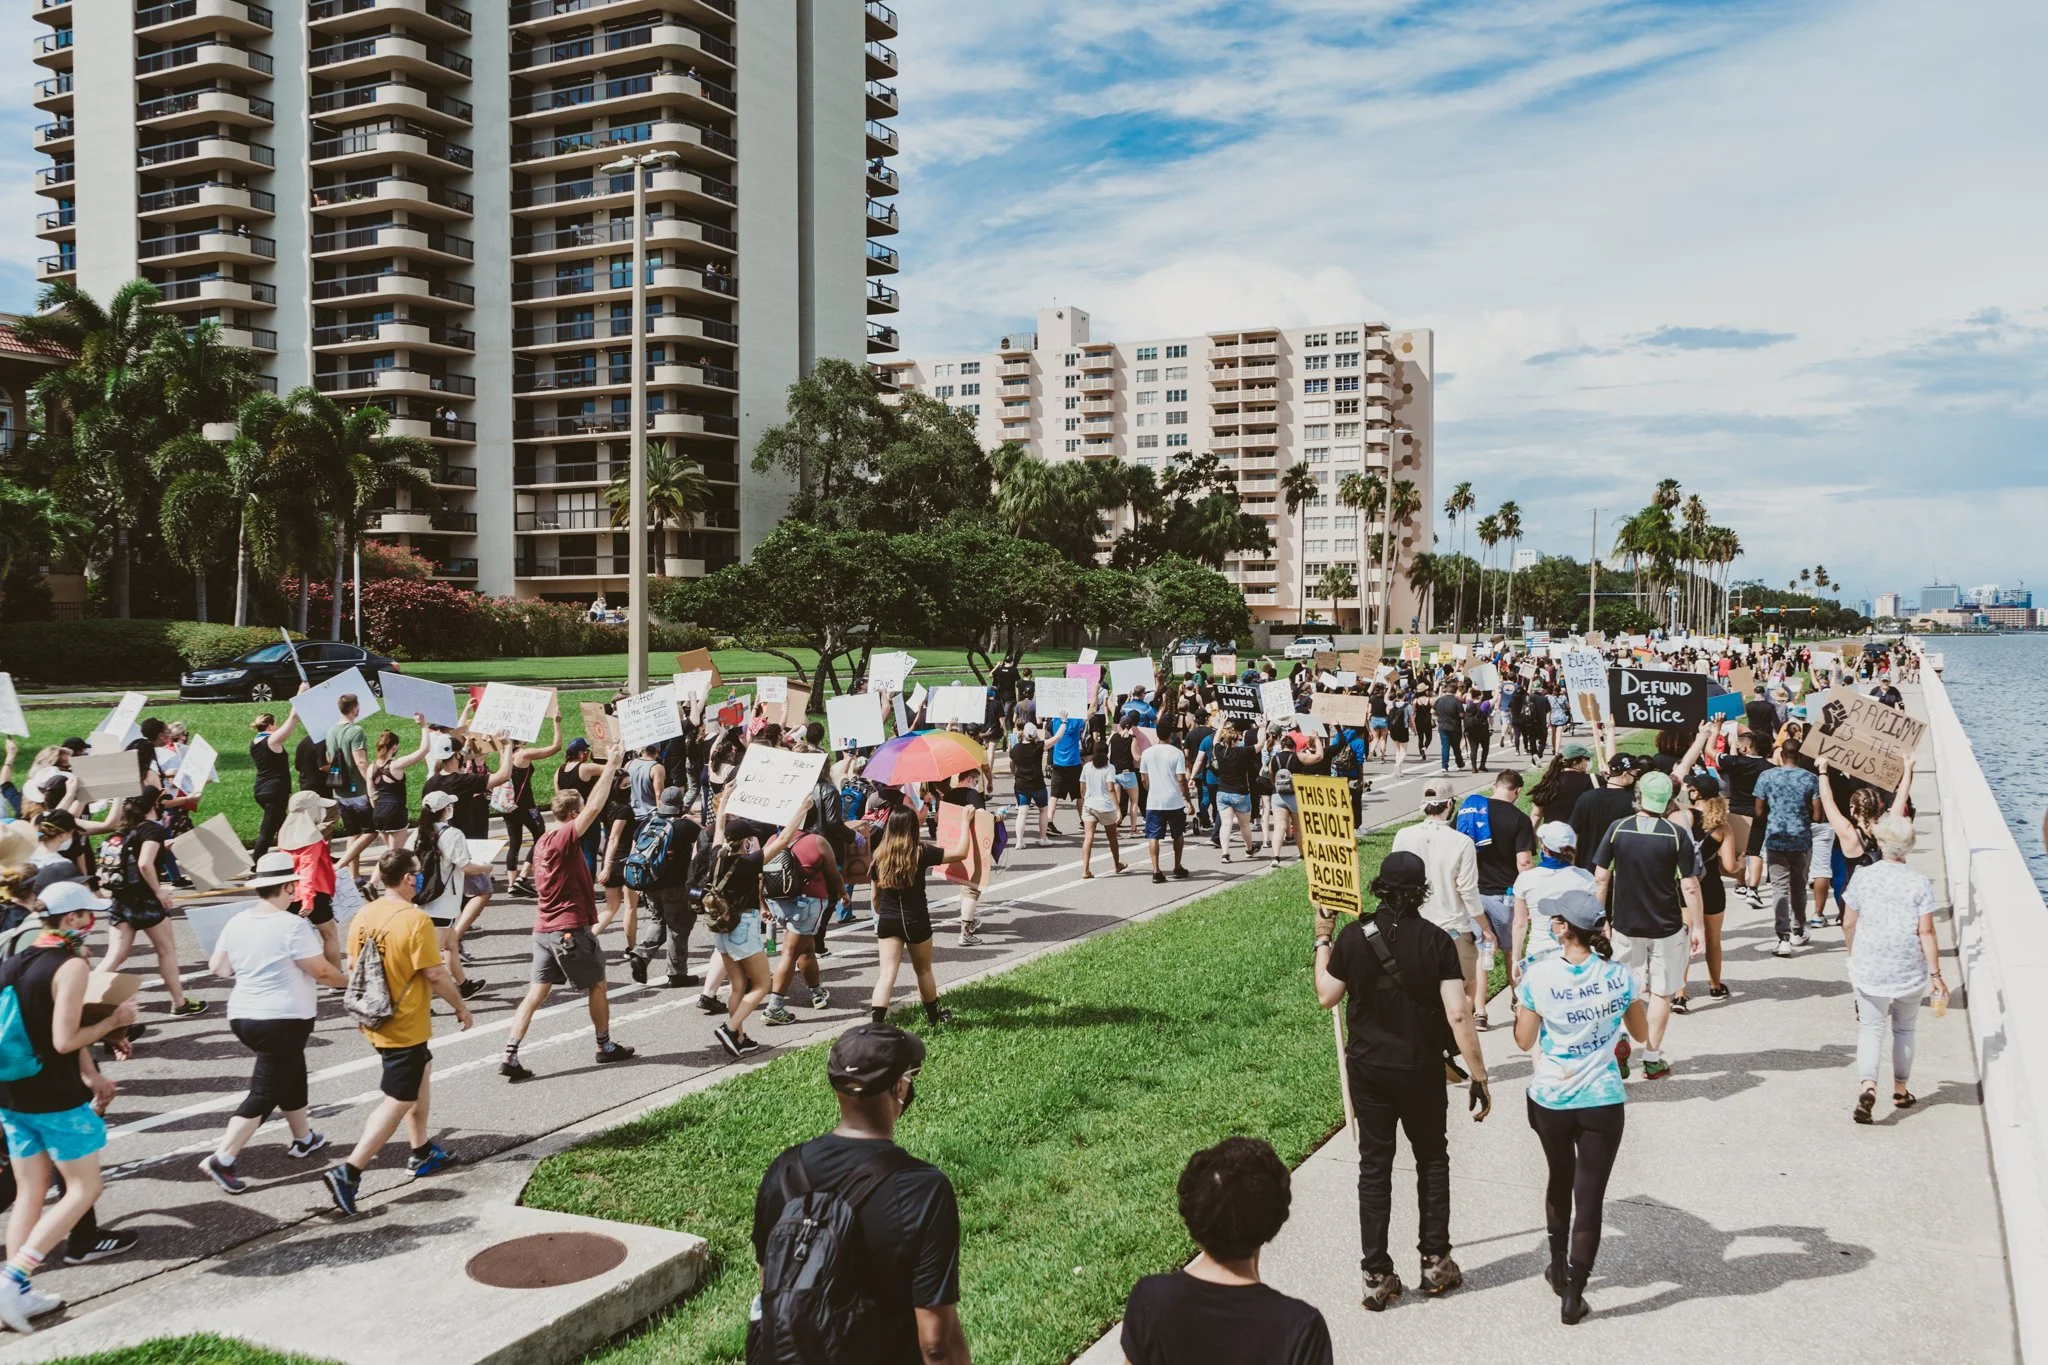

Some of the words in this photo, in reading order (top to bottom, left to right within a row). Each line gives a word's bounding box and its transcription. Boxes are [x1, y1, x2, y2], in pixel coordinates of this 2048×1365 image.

[1567, 654, 1599, 668] BLACK
[1217, 685, 1254, 697] BLACK
[1570, 677, 1606, 689] MATTER
[1621, 670, 1693, 696] DEFUND
[1222, 698, 1255, 708] LIVES
[1644, 695, 1668, 706] the
[1848, 699, 1924, 747] RACISM
[1835, 723, 1855, 742] IS
[1870, 735, 1900, 761] THE
[1818, 737, 1876, 775] VIRUS
[1297, 785, 1325, 806] THIS
[1326, 787, 1338, 808] IS
[1341, 789, 1349, 809] A
[1303, 811, 1351, 840] REVOLT
[1550, 987, 1573, 1000] WE
[1578, 983, 1603, 999] ARE
[1607, 977, 1624, 993] ALL
